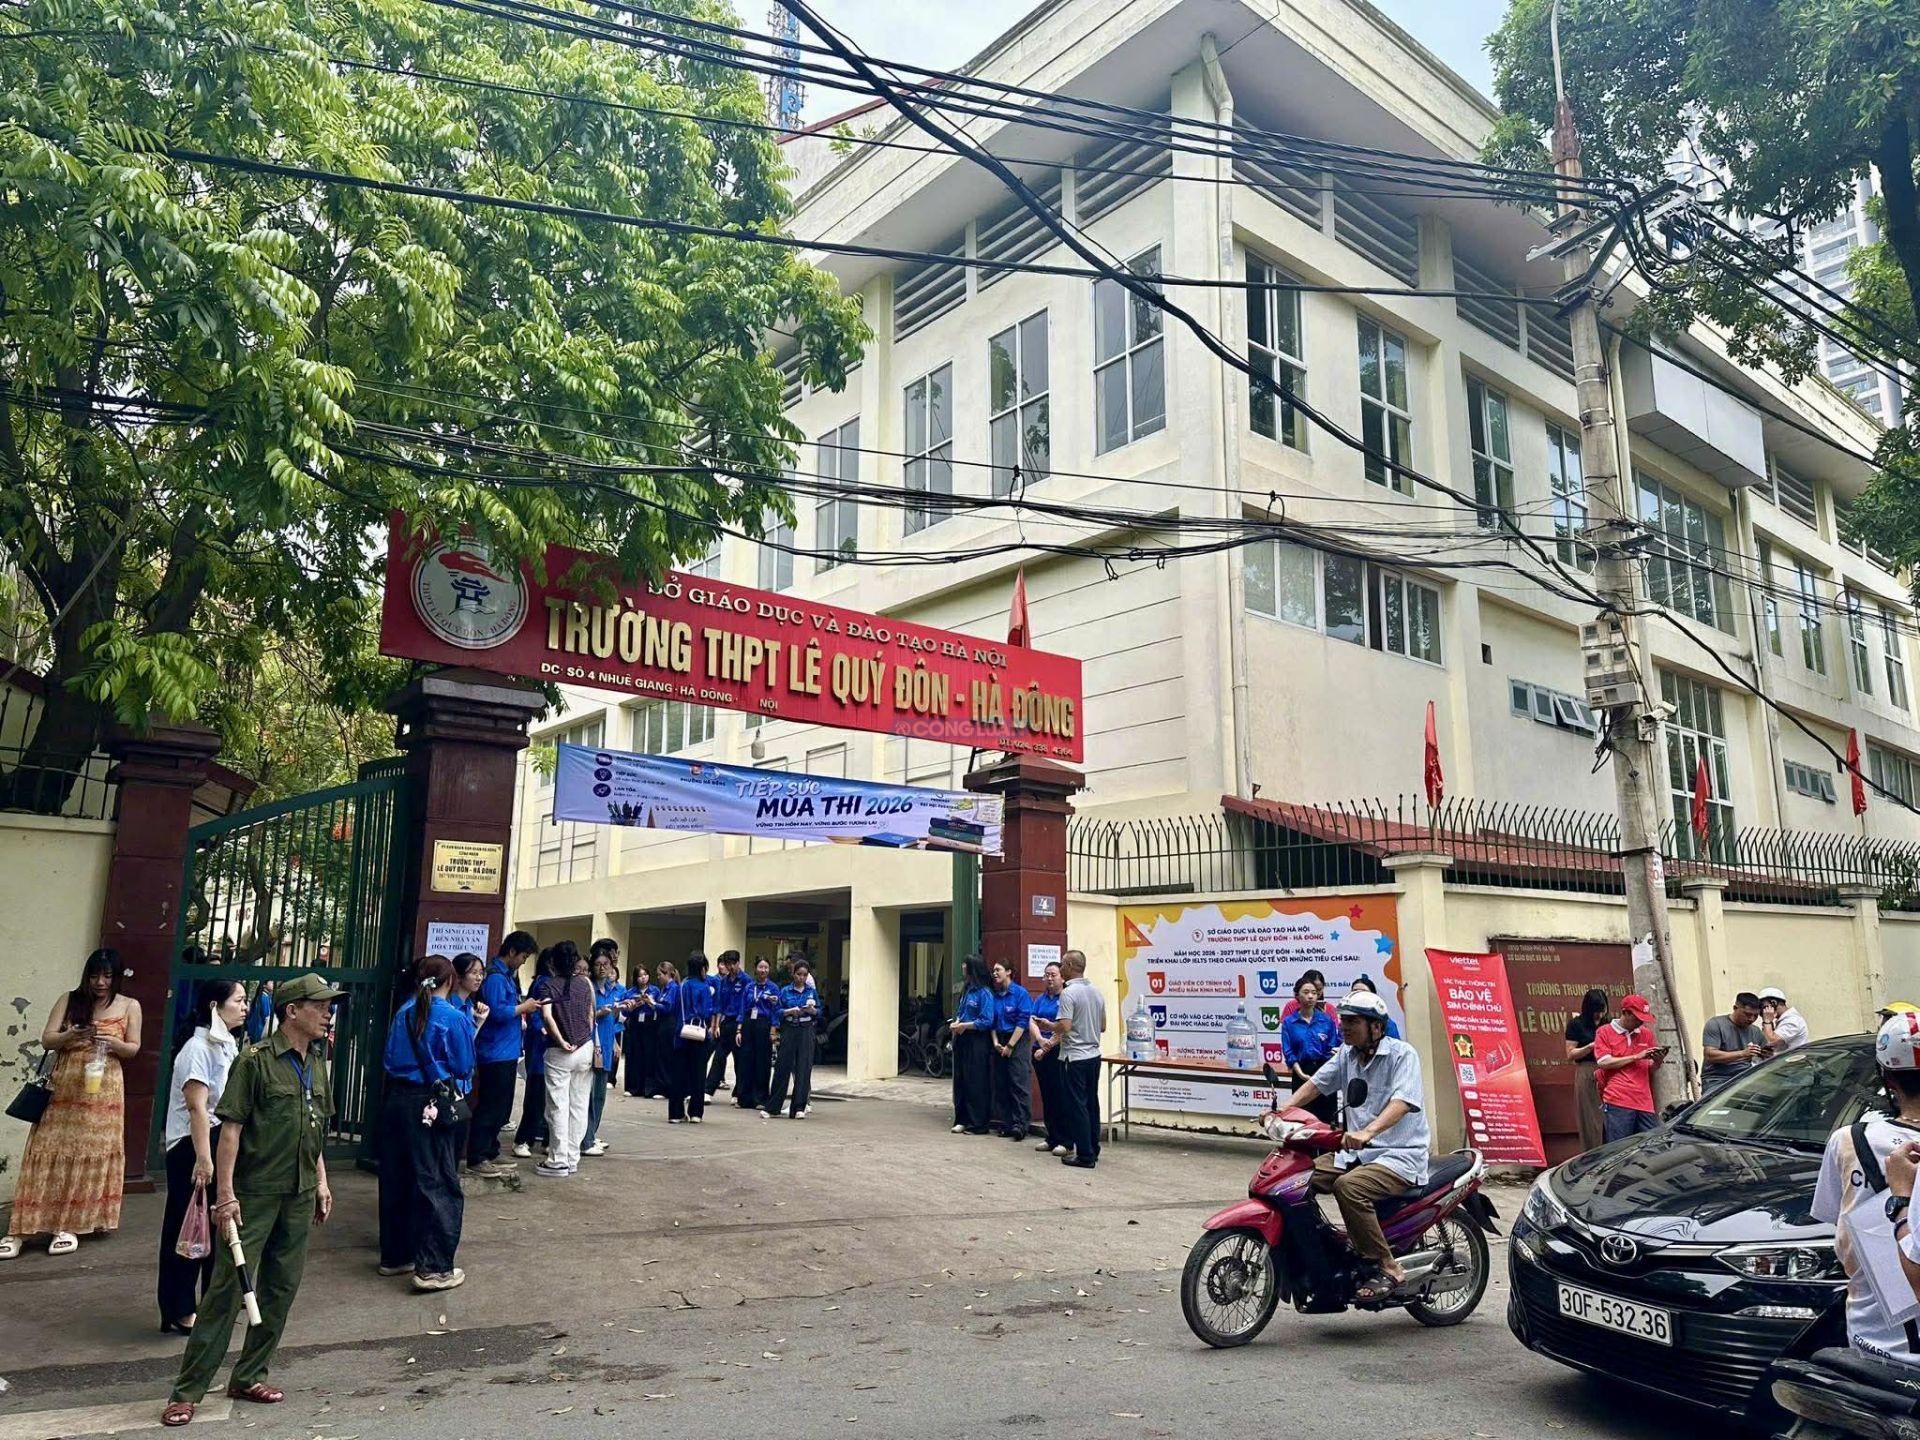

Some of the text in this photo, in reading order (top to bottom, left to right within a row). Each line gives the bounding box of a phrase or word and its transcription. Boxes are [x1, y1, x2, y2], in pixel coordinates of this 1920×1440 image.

[688, 588, 751, 613] GIÁO
[757, 602, 804, 626] DỤC
[811, 611, 841, 634] VÀ
[847, 619, 891, 643] ĐÀO
[896, 632, 937, 653] TẠO
[940, 639, 968, 660] HÀ
[973, 646, 1007, 669] NỘI
[545, 596, 692, 673] TRƯỜNG
[704, 627, 781, 687] THPT
[789, 636, 822, 695] LÊ
[832, 651, 886, 706] QUÝ
[894, 657, 949, 716] ĐÔN
[954, 692, 965, 703] -
[971, 671, 1004, 725] HÀ
[1012, 680, 1075, 738] ĐÔNG
[588, 671, 595, 680] 4
[635, 678, 673, 693] GIANG
[680, 684, 696, 697] HÀ
[759, 698, 778, 713] NỘI
[735, 777, 822, 798] TIẾP SỨC
[756, 795, 913, 819] MÙA THI 2026
[1217, 927, 1232, 935] GIÁO
[1247, 926, 1256, 934] VÀ
[1287, 925, 1297, 933] HÀ
[1298, 925, 1310, 933] NỘI
[1207, 935, 1233, 943] TRƯỜNG
[1252, 948, 1260, 956] LÊ
[1275, 947, 1290, 955] ĐÔN
[1295, 947, 1305, 955] HÀ
[1151, 979, 1163, 988] 01
[1262, 979, 1277, 988] 02
[1526, 980, 1560, 996] TRƯỜNG
[1562, 983, 1588, 996] TRUNG
[1448, 986, 1493, 1003] BẢO VỆ
[1152, 1012, 1165, 1021] 03
[1262, 1014, 1278, 1024] 04
[1518, 1006, 1568, 1035] LÊ QUÝ
[1265, 1050, 1281, 1061] 06
